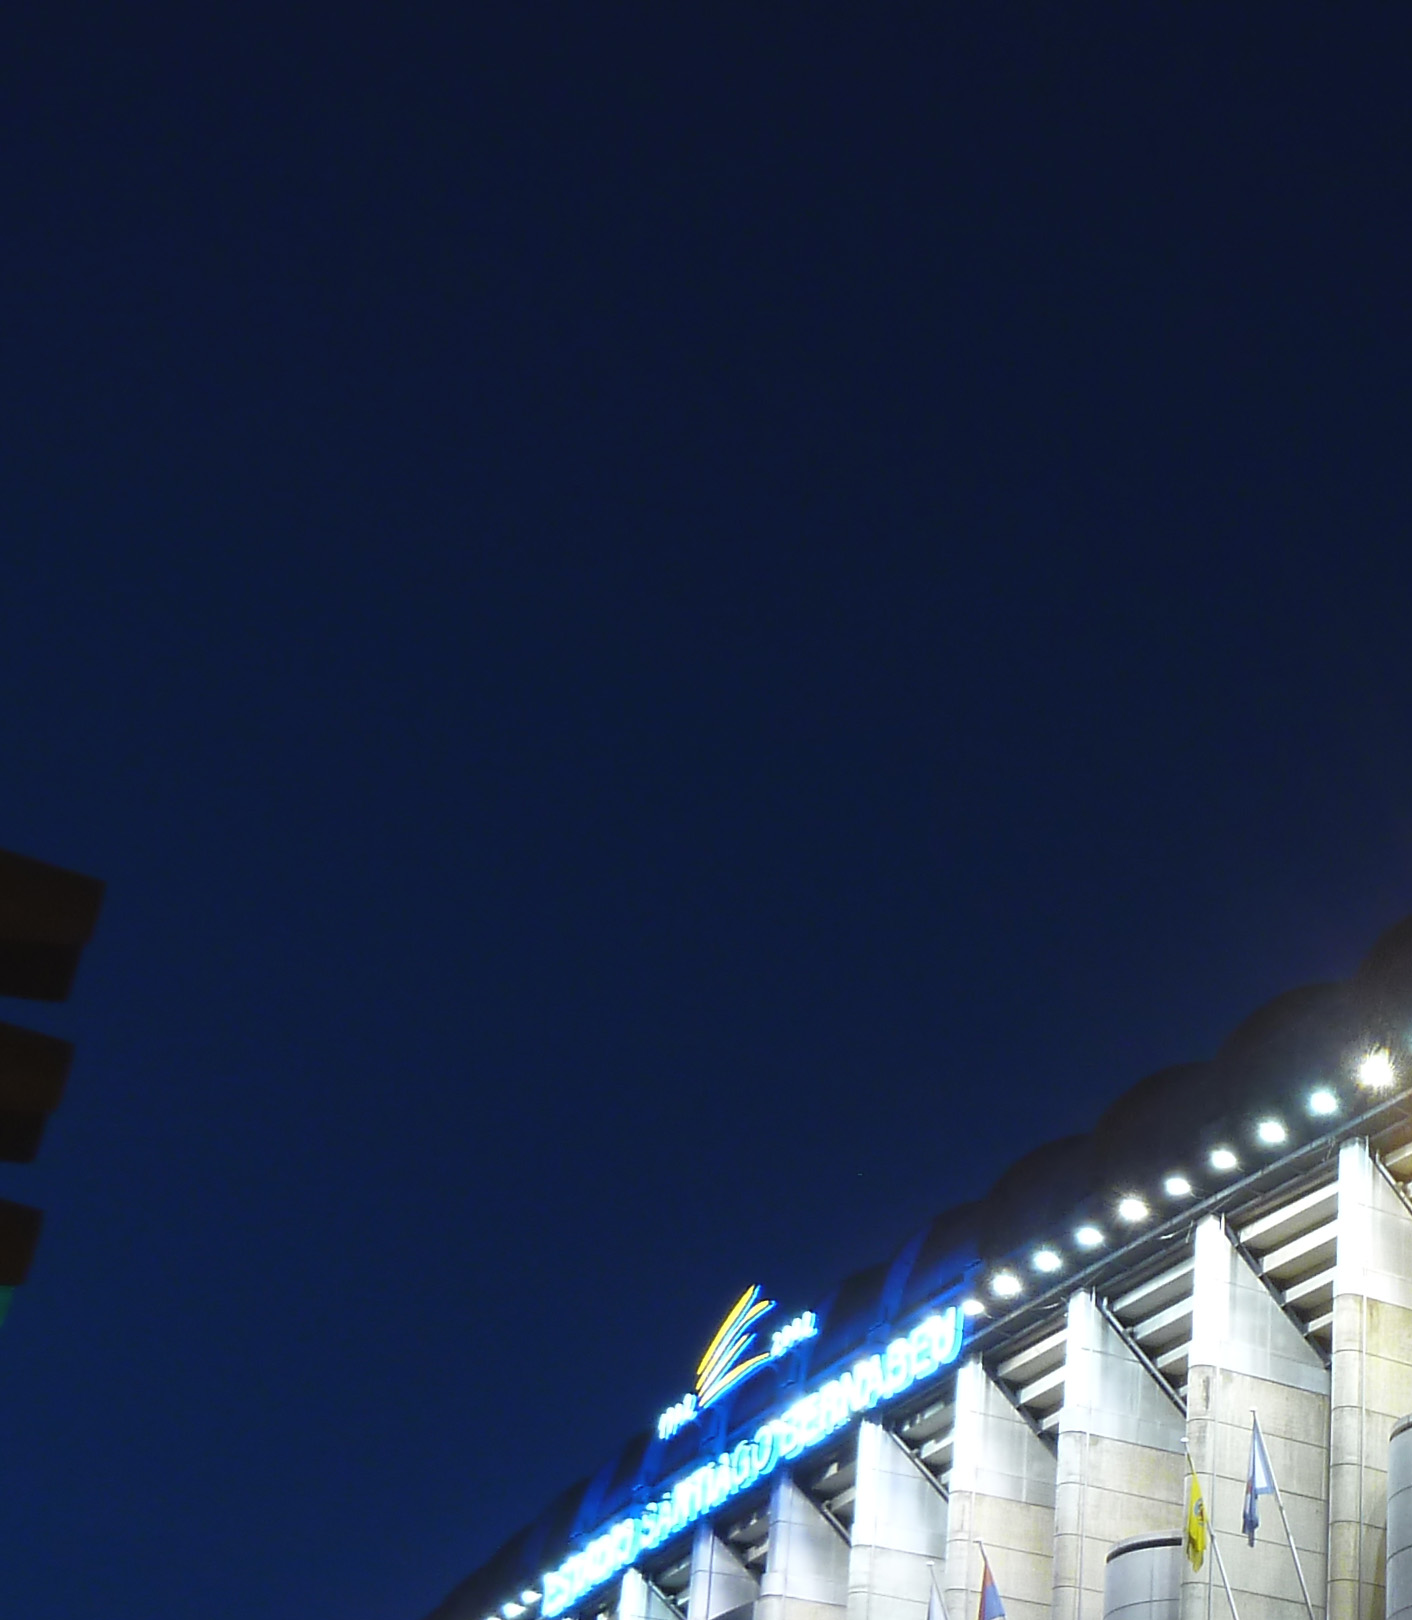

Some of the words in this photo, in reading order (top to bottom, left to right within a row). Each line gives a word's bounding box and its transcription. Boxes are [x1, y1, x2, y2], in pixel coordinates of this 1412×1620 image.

[541, 1518, 643, 1617] ESTADIO
[642, 1424, 779, 1549] SANTIAGO
[776, 1306, 964, 1459] BERNABEU
